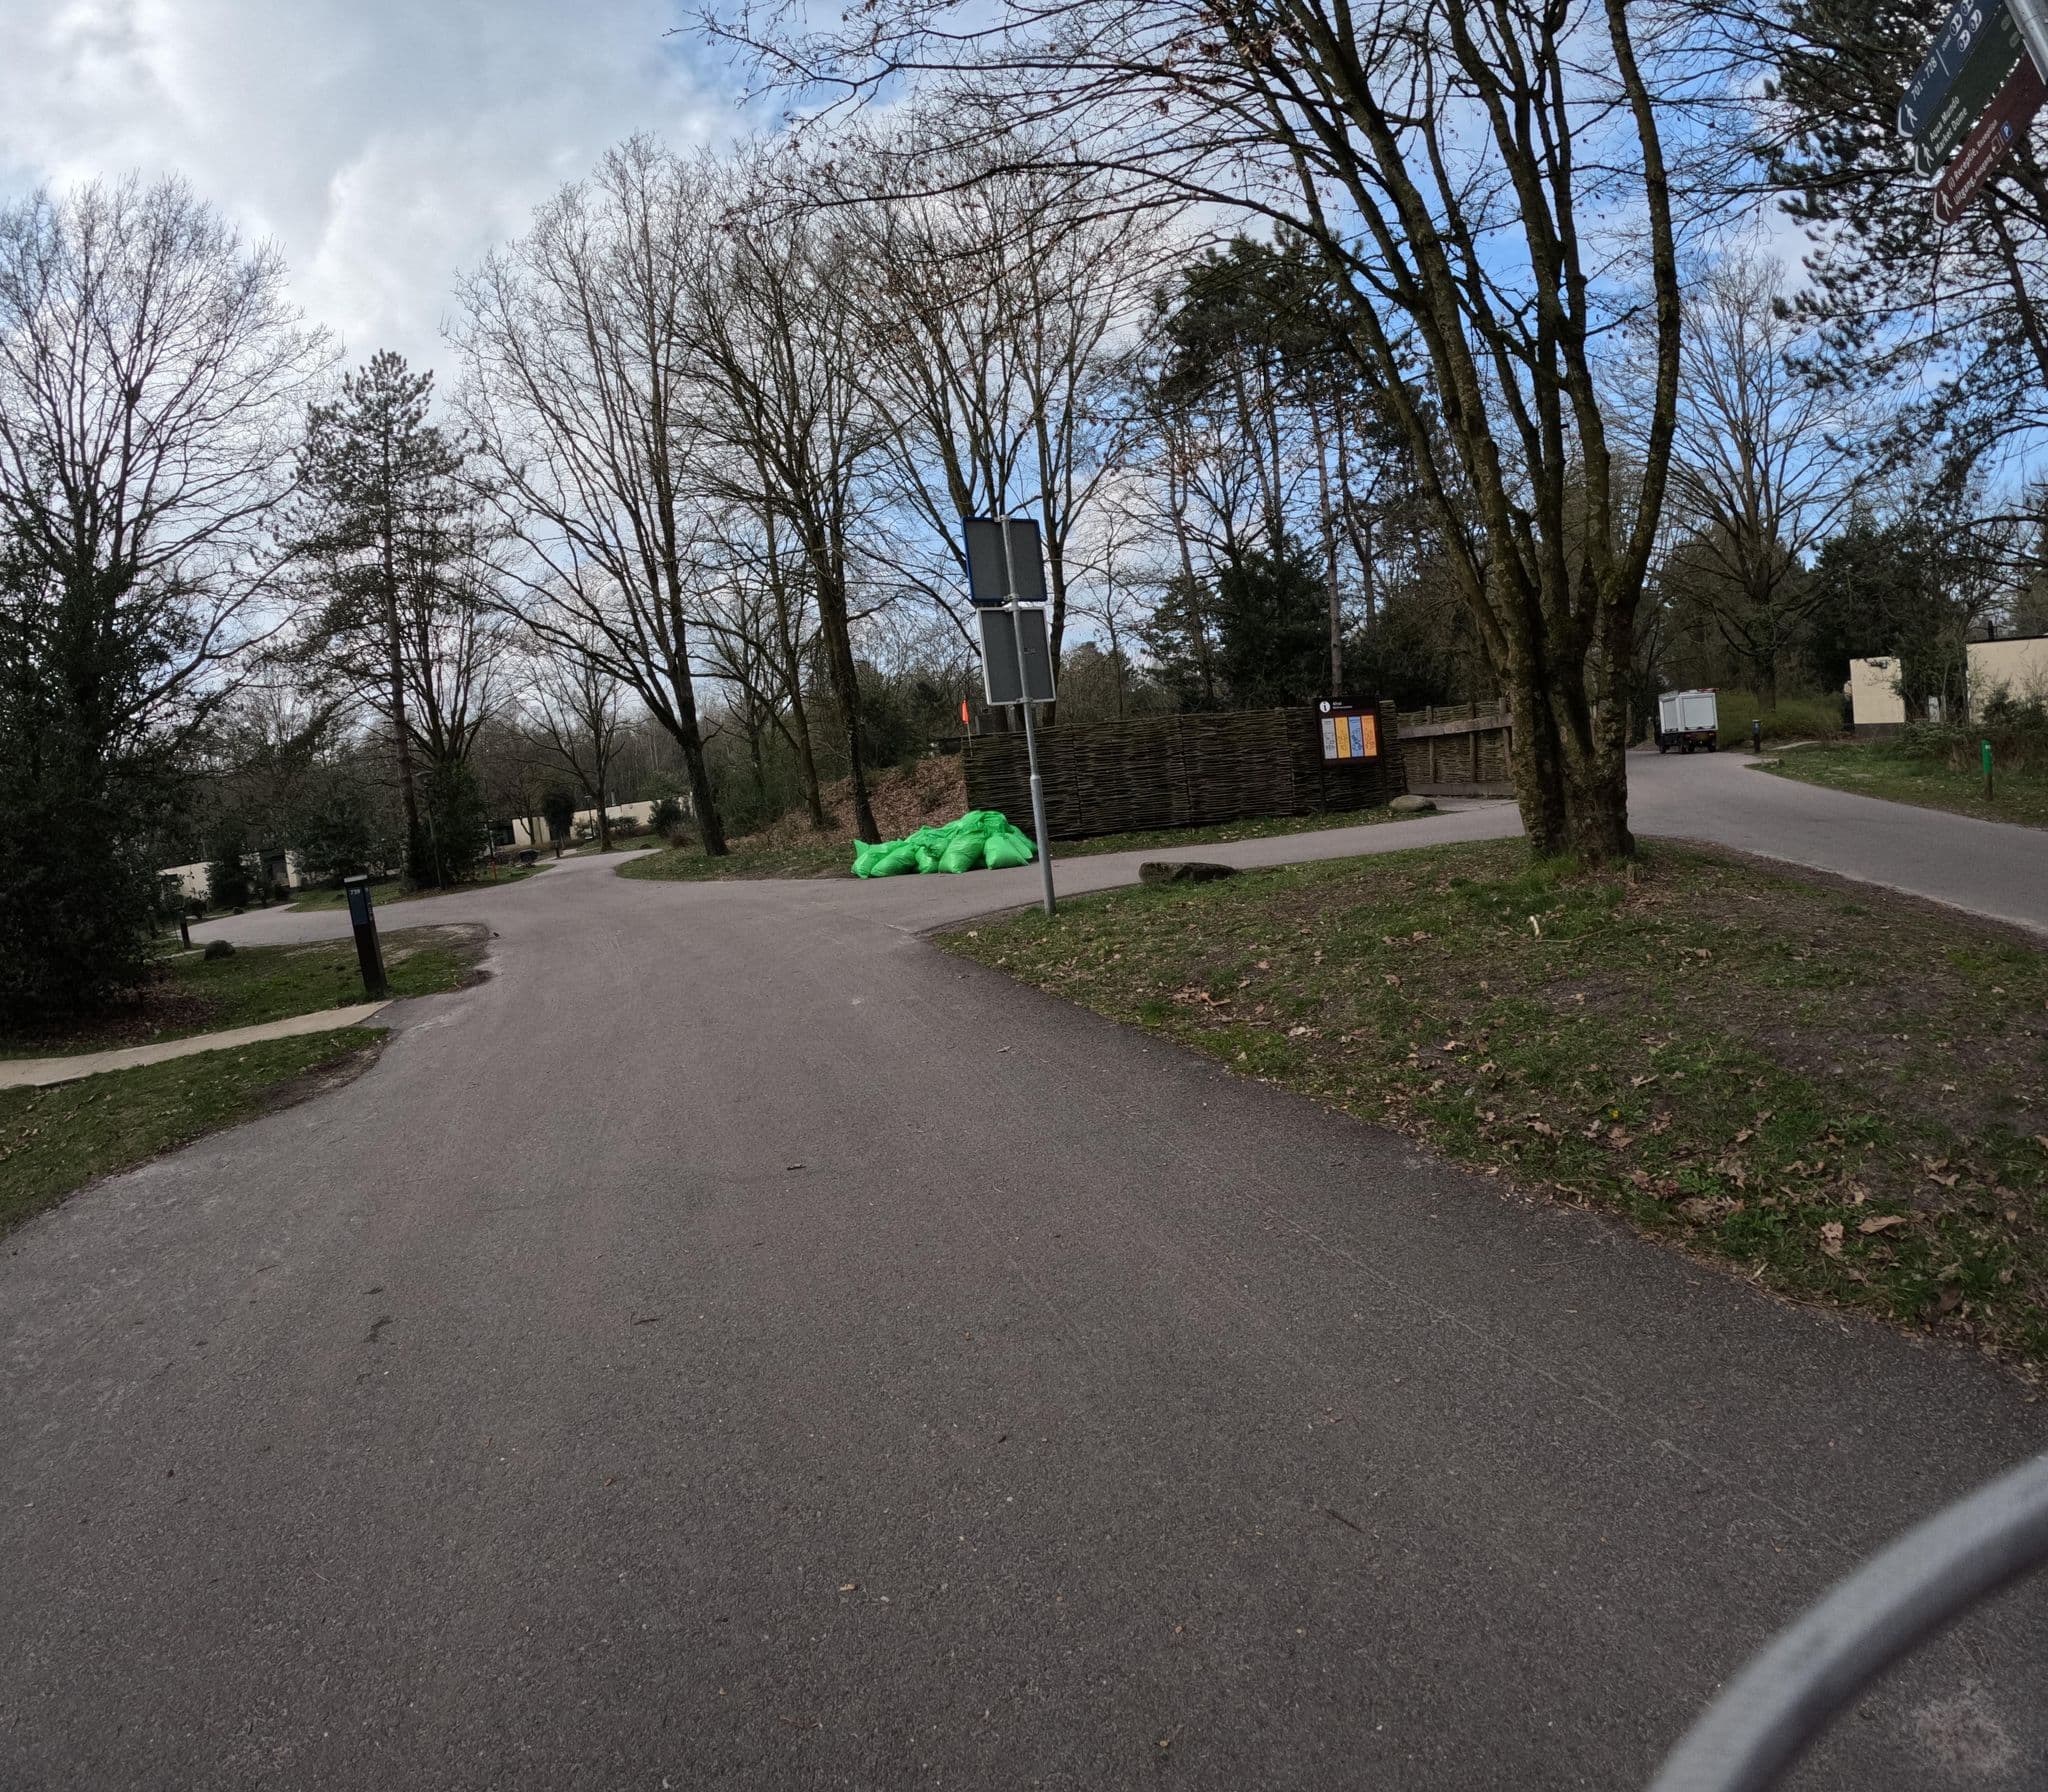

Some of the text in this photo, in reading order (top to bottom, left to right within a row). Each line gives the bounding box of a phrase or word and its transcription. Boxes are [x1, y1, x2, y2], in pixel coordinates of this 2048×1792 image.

[1911, 80, 1923, 101] 701
[1924, 57, 1937, 78] 728
[1930, 96, 1960, 142] Aqua Mundo
[1935, 107, 1968, 155] Market Dome
